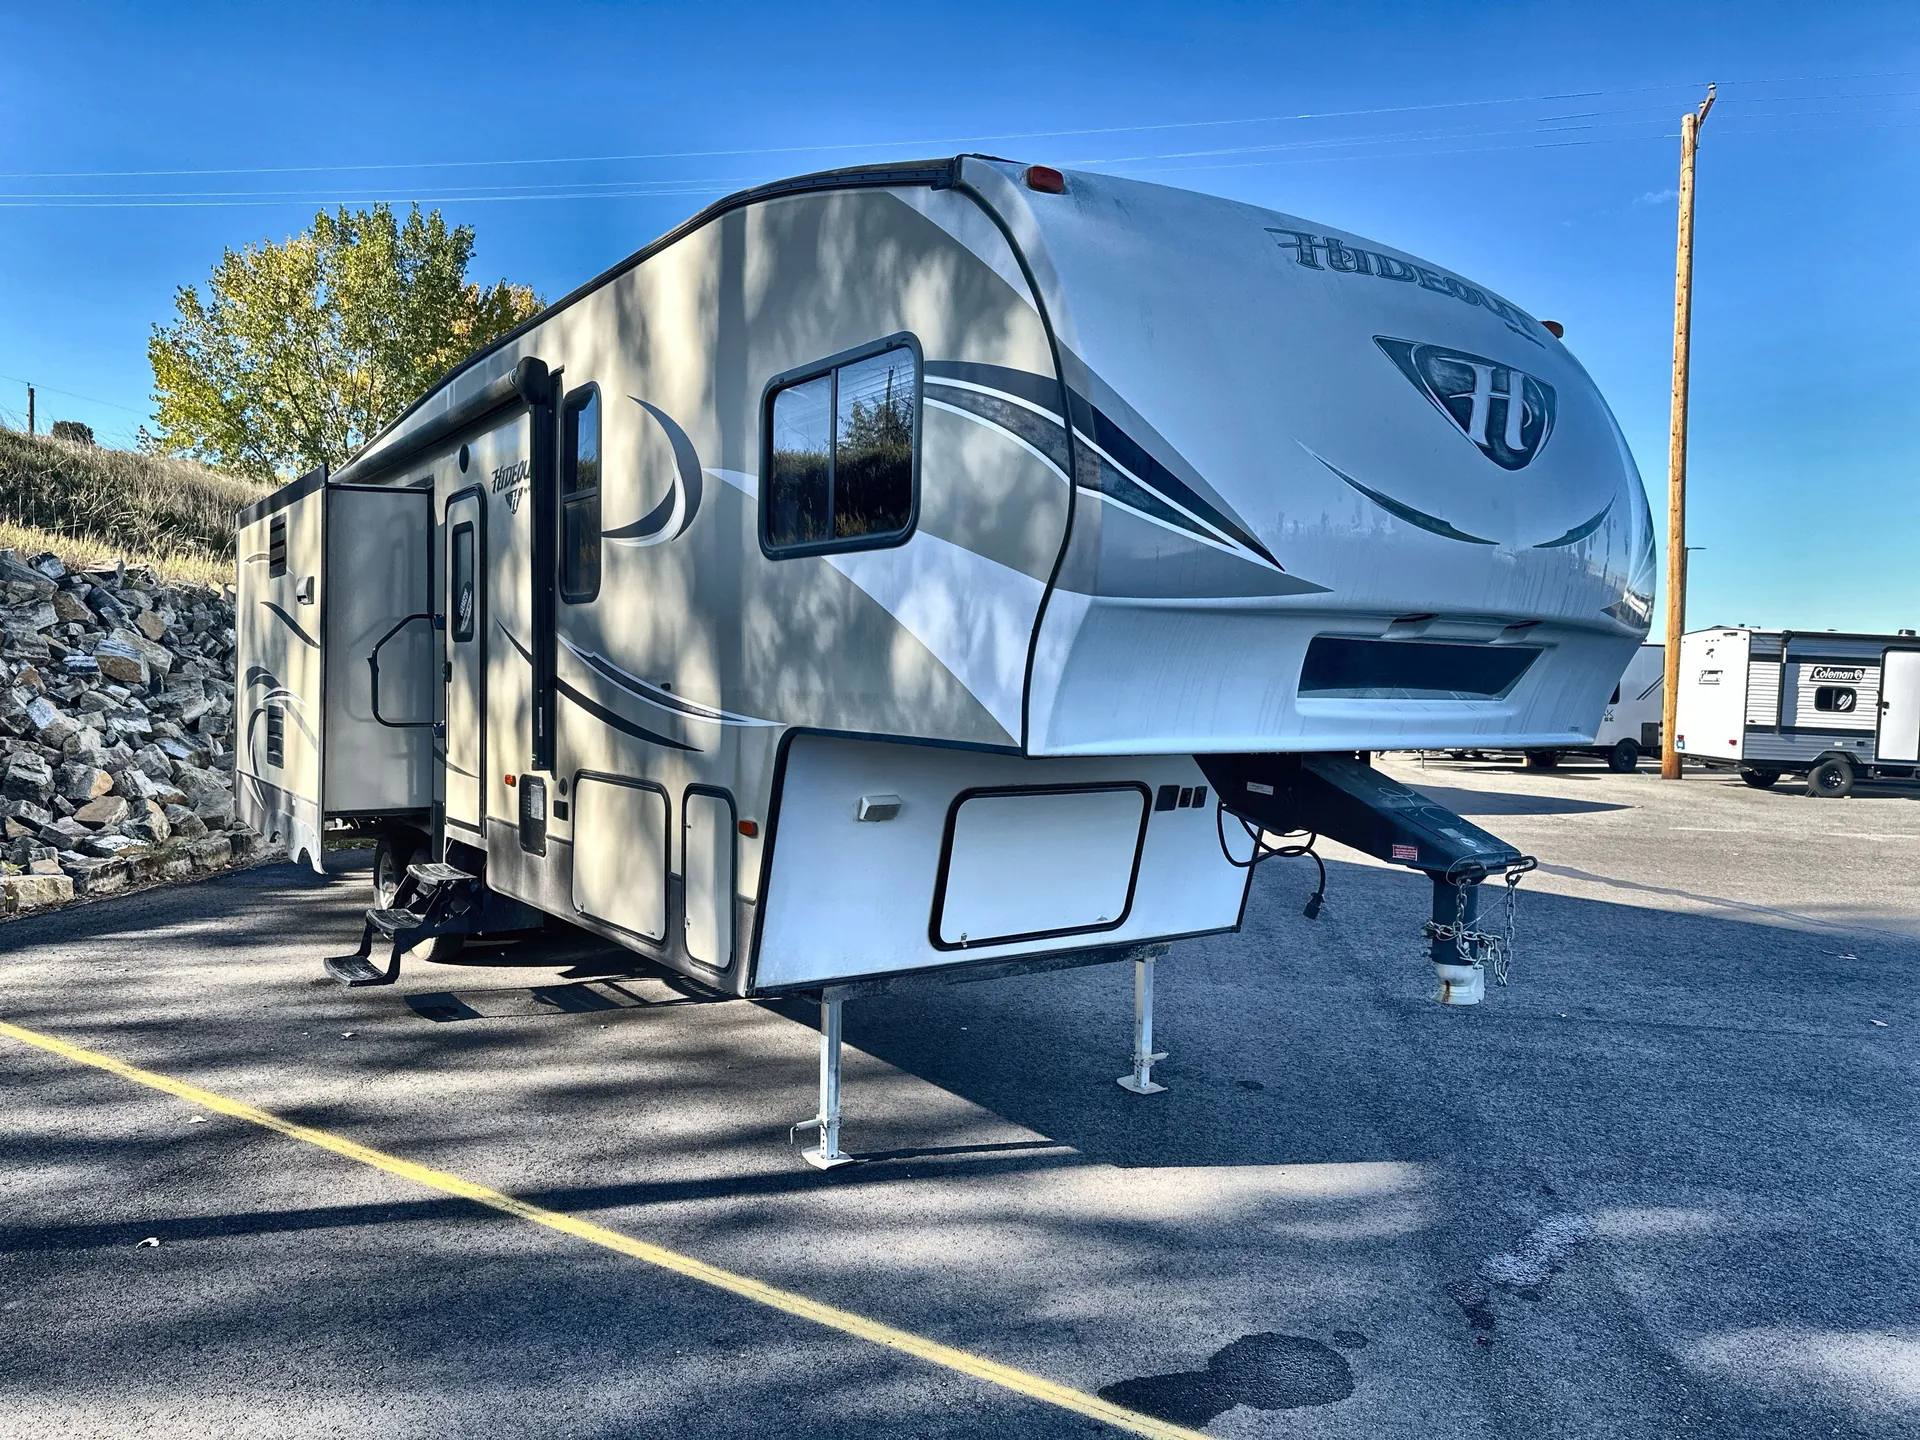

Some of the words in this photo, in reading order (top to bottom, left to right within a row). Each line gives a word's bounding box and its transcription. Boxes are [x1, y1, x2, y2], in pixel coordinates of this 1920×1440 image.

[1437, 357, 1532, 452] H
[491, 460, 530, 494] HIDEOU
[1813, 667, 1854, 680] Coleman
